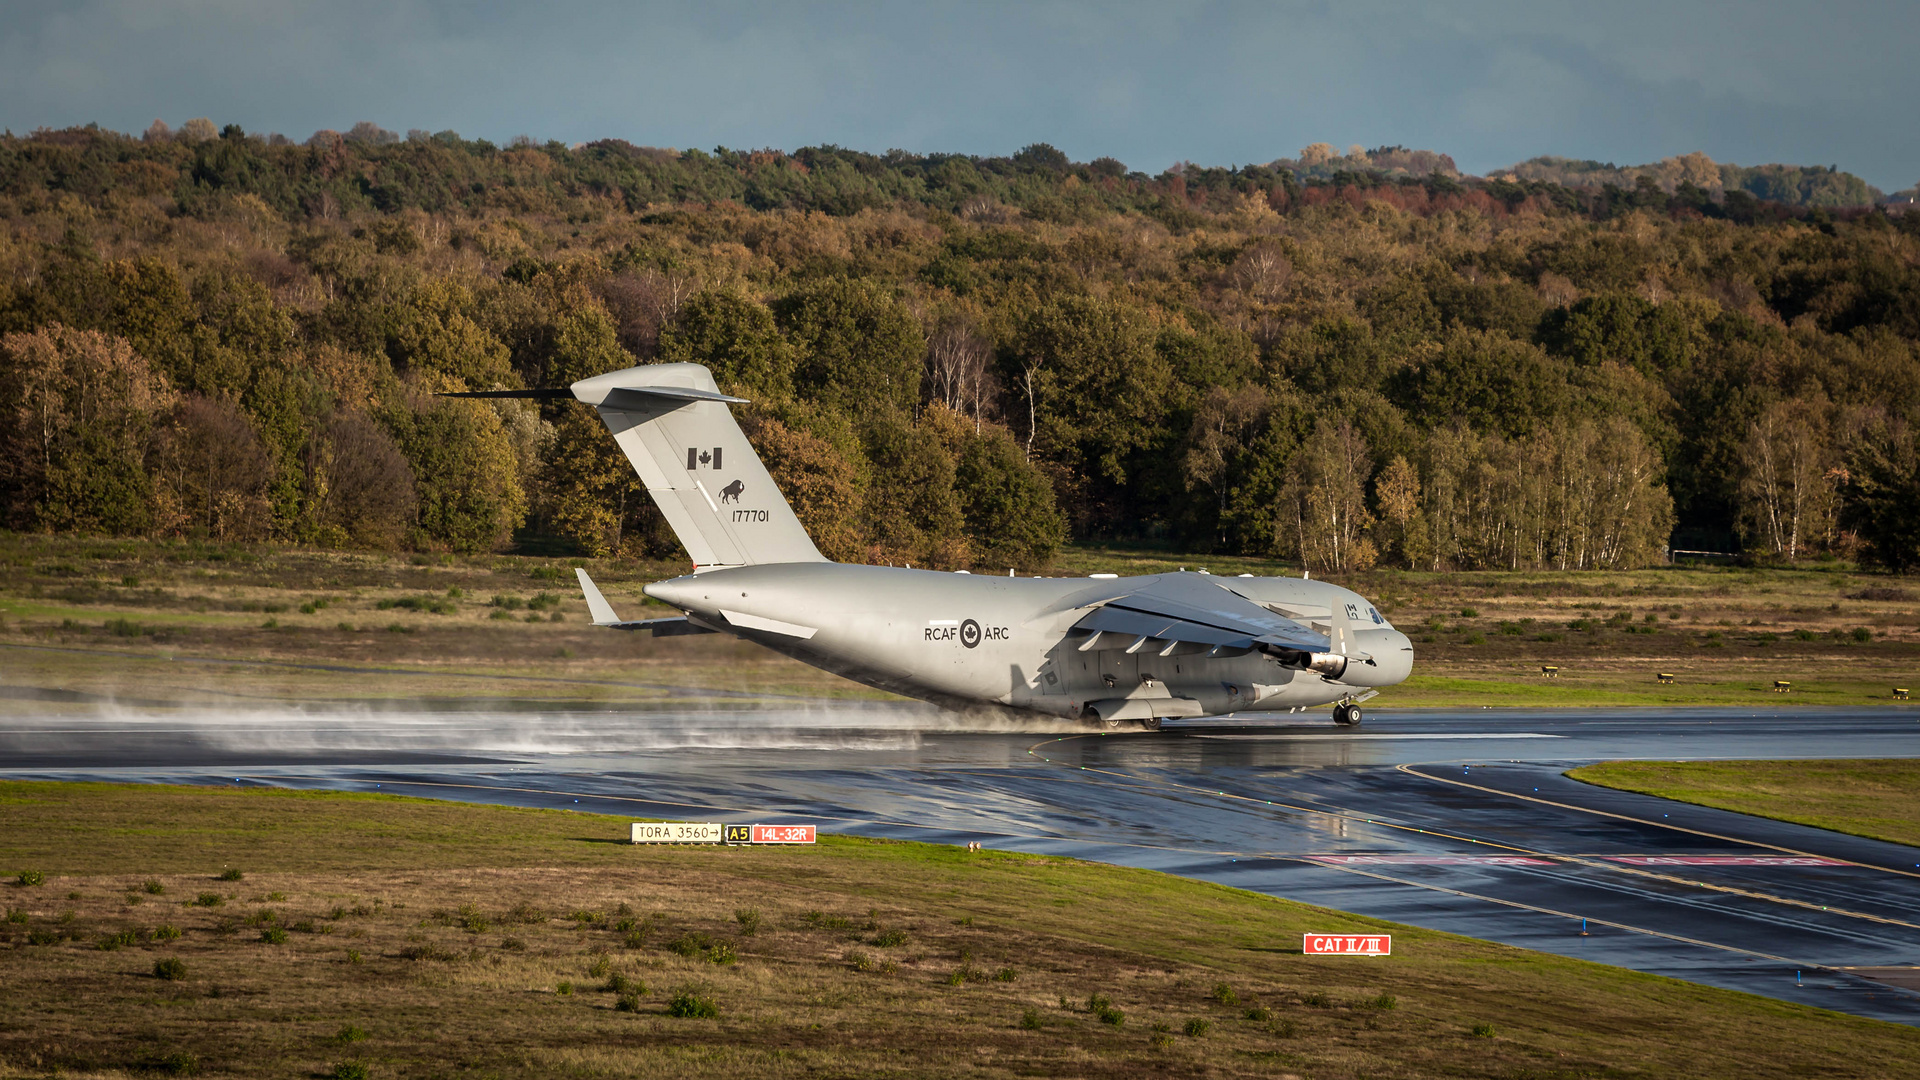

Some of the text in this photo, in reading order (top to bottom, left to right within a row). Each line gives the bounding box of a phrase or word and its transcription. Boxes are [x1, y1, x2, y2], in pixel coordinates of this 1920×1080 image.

[732, 510, 769, 522] 177701
[924, 627, 1009, 641] RCAF ARC
[639, 826, 709, 838] TORA 3560
[729, 827, 748, 840] A5
[761, 828, 807, 841] 14L-32R
[1313, 937, 1381, 952] CAT II/III
